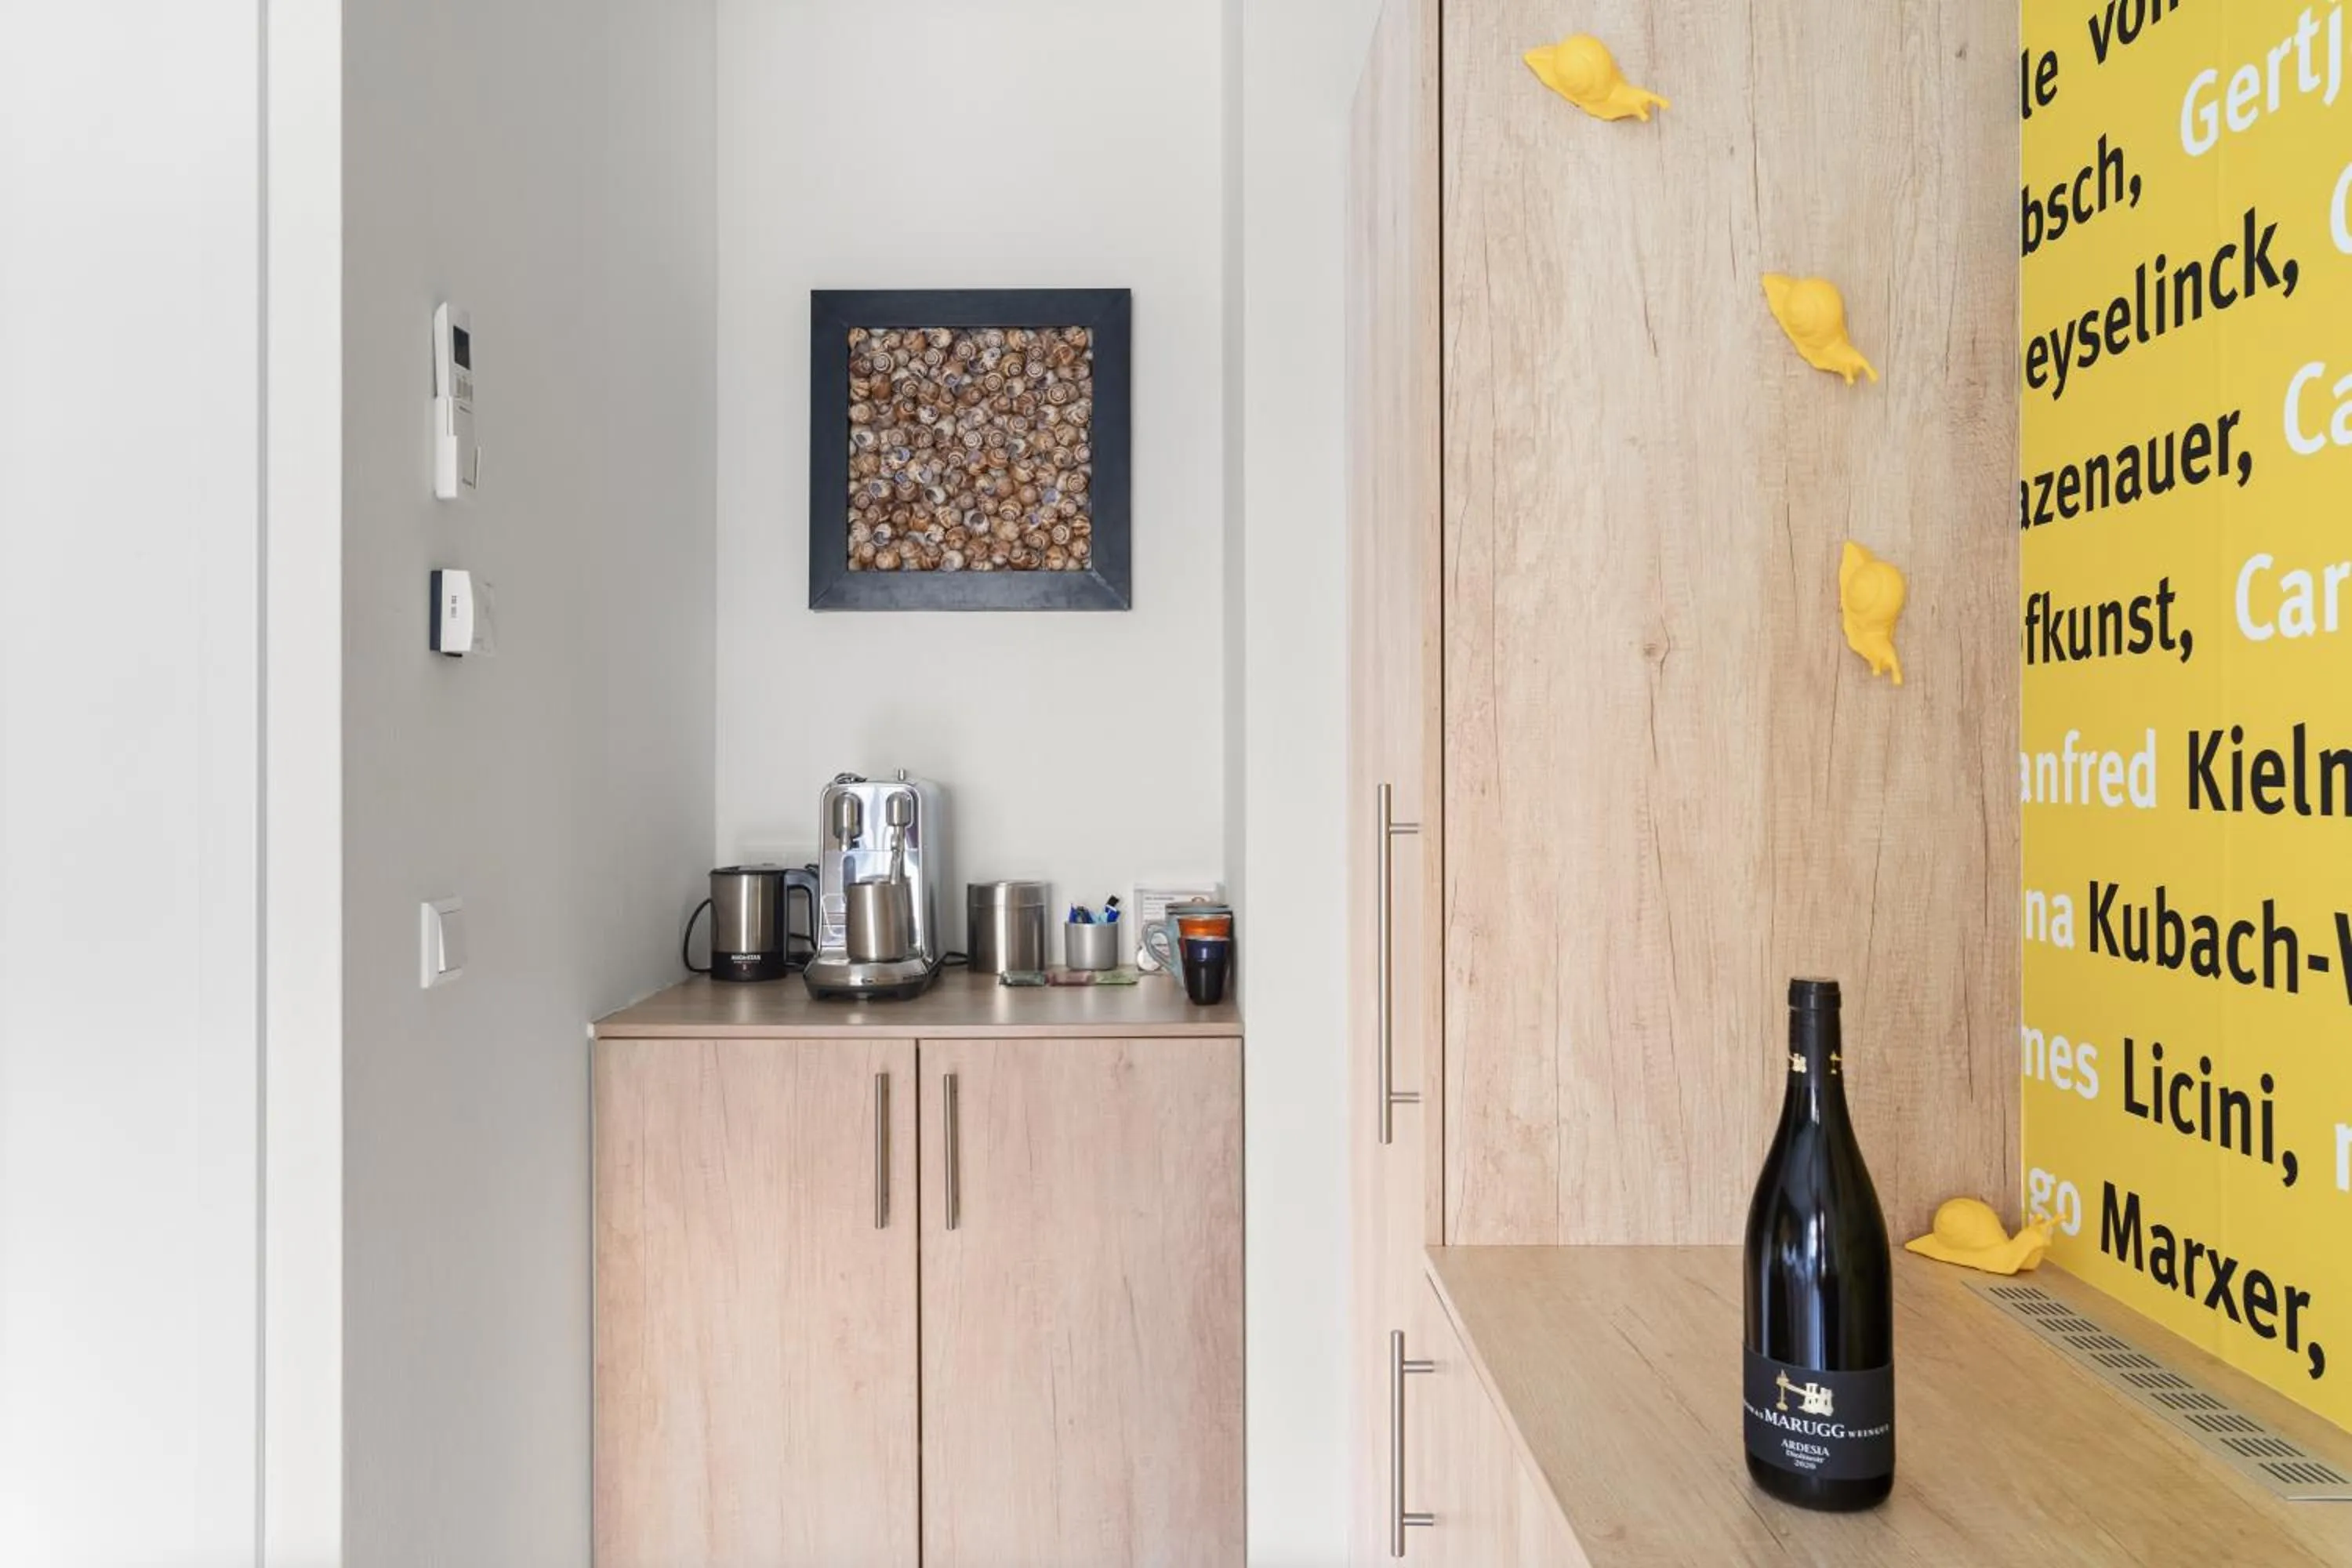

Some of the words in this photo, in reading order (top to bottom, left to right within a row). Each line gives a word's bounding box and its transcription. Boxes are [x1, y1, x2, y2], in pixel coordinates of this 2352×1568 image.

[2021, 48, 2058, 119] le
[2021, 133, 2141, 257] bsch,
[2025, 206, 2299, 401] eyselinck,
[2021, 576, 2193, 664] fkunst,
[2025, 889, 2074, 949] na
[2124, 1037, 2298, 1187] Licini,
[2100, 1180, 2325, 1380] Marxer,
[1763, 1408, 1845, 1439] MARUGG
[1781, 1439, 1830, 1457] ARDESIA
